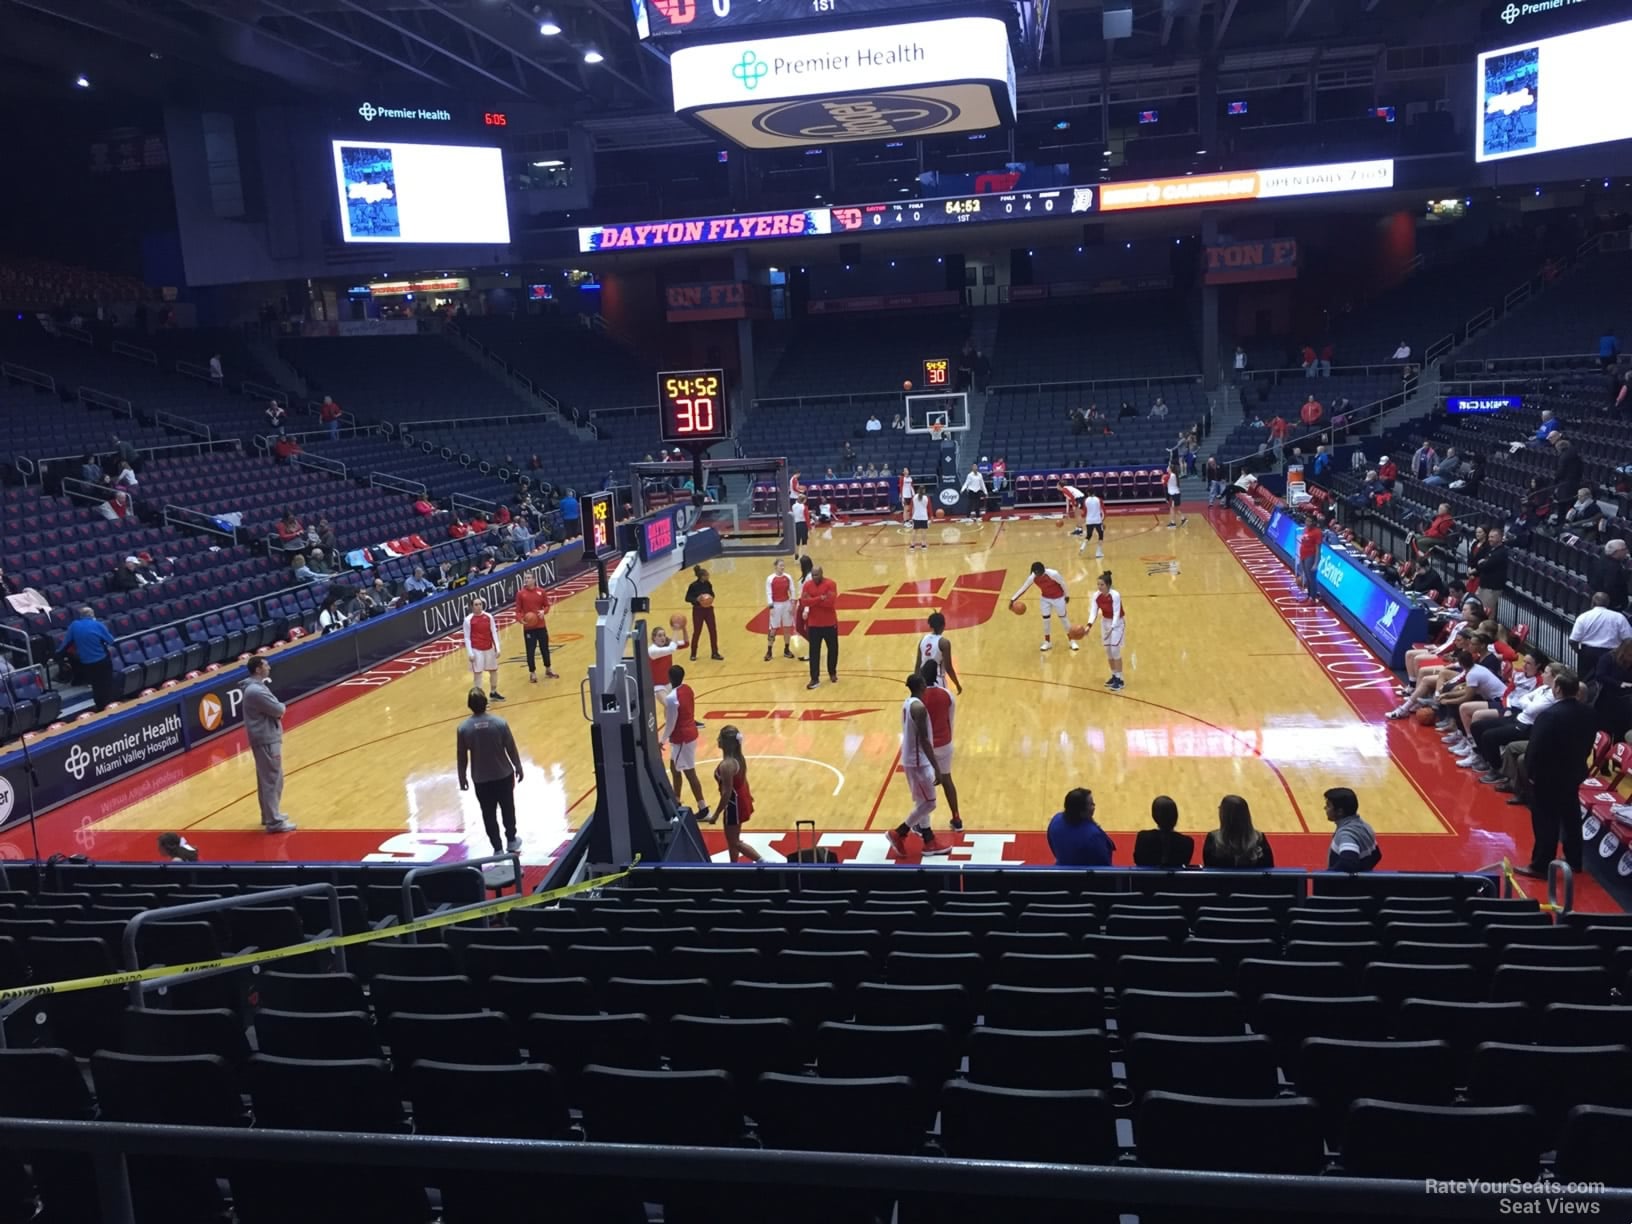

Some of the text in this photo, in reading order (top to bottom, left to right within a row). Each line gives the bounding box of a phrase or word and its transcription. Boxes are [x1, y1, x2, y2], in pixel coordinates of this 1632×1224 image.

[774, 43, 925, 76] Premier Health
[378, 106, 451, 121] Premier Health
[485, 113, 506, 126] 6:05
[1005, 203, 1013, 214] 0
[1024, 202, 1032, 212] 4
[1044, 200, 1054, 212] 0
[873, 214, 882, 225] 0
[895, 212, 902, 223] 4
[913, 211, 921, 221] 0
[957, 214, 970, 223] 1ST
[600, 213, 807, 249] DAYTON FLYERS
[930, 370, 945, 383] 30
[666, 377, 718, 398] 54:52
[676, 398, 713, 432] 30
[925, 643, 932, 656] 2
[1288, 618, 1403, 690] DAYTON
[92, 713, 182, 762] Premier Health
[95, 733, 180, 777] Miami Valley Hospital
